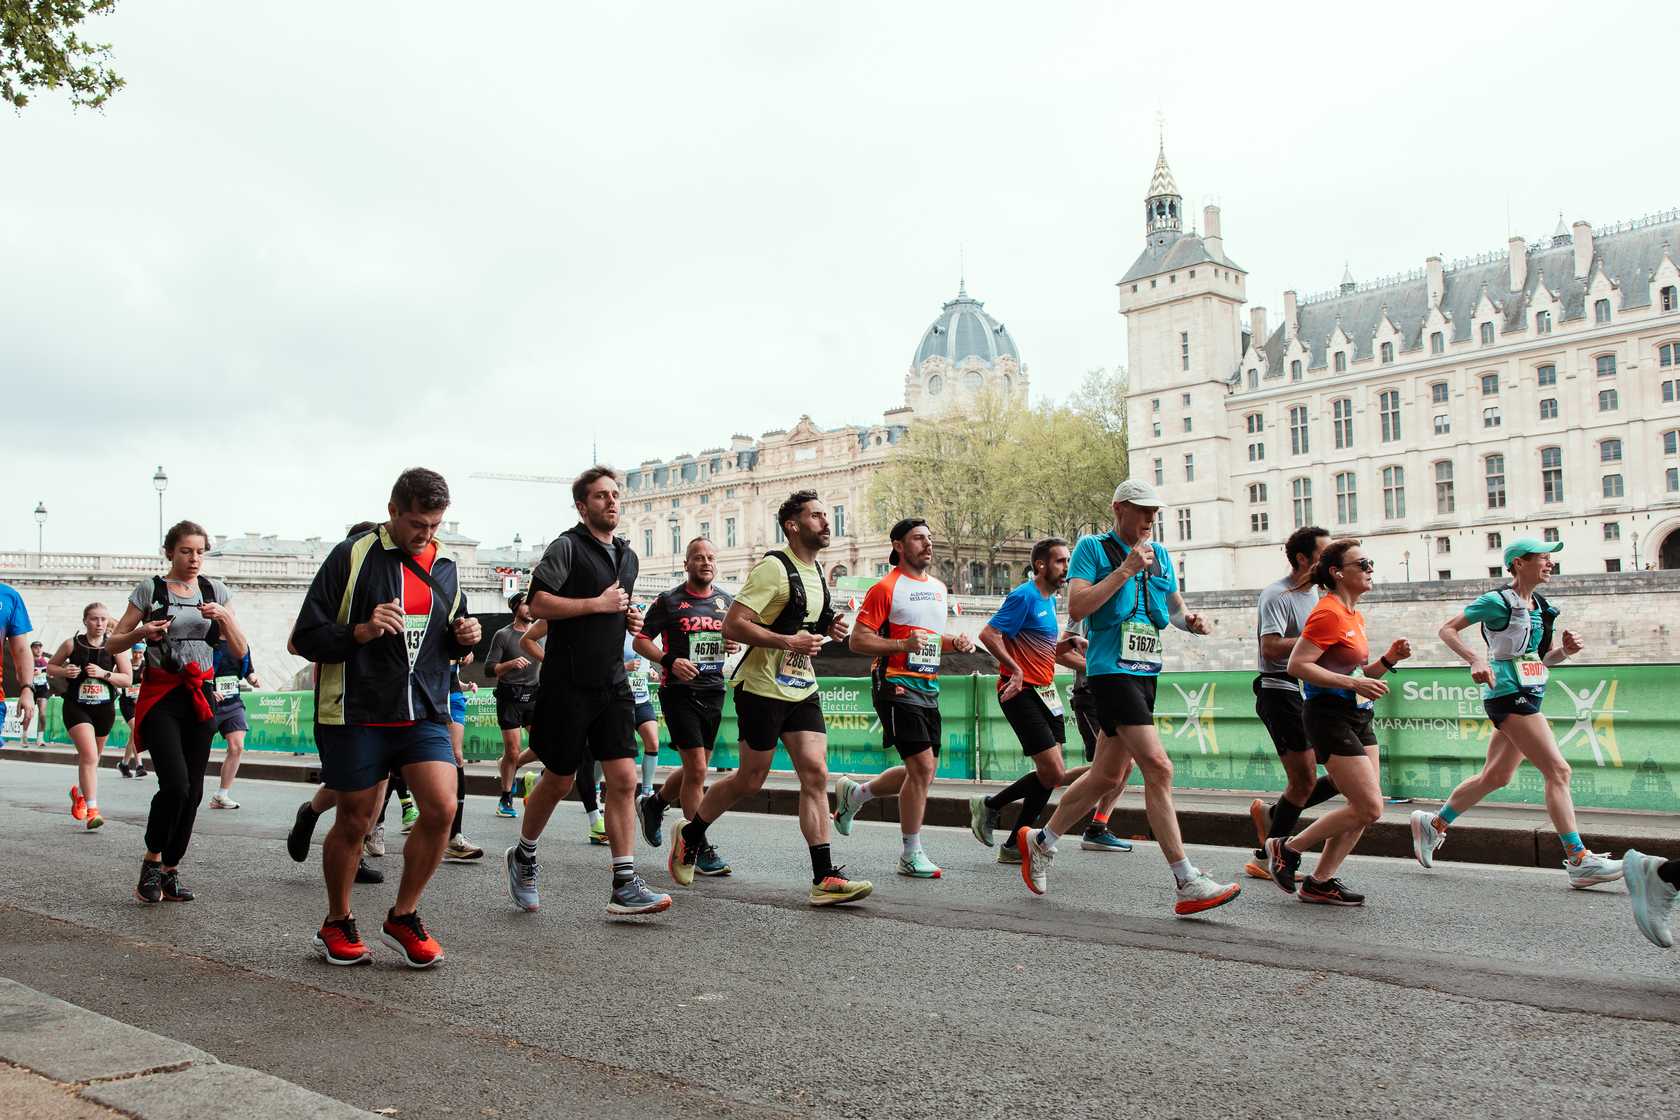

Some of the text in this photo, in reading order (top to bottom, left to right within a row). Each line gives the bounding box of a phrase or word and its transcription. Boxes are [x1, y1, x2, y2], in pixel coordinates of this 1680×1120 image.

[680, 616, 723, 631] 32Re
[819, 687, 860, 701] neider
[822, 702, 858, 711] Electric
[1372, 719, 1459, 730] MARATHON
[1447, 731, 1459, 740] DE
